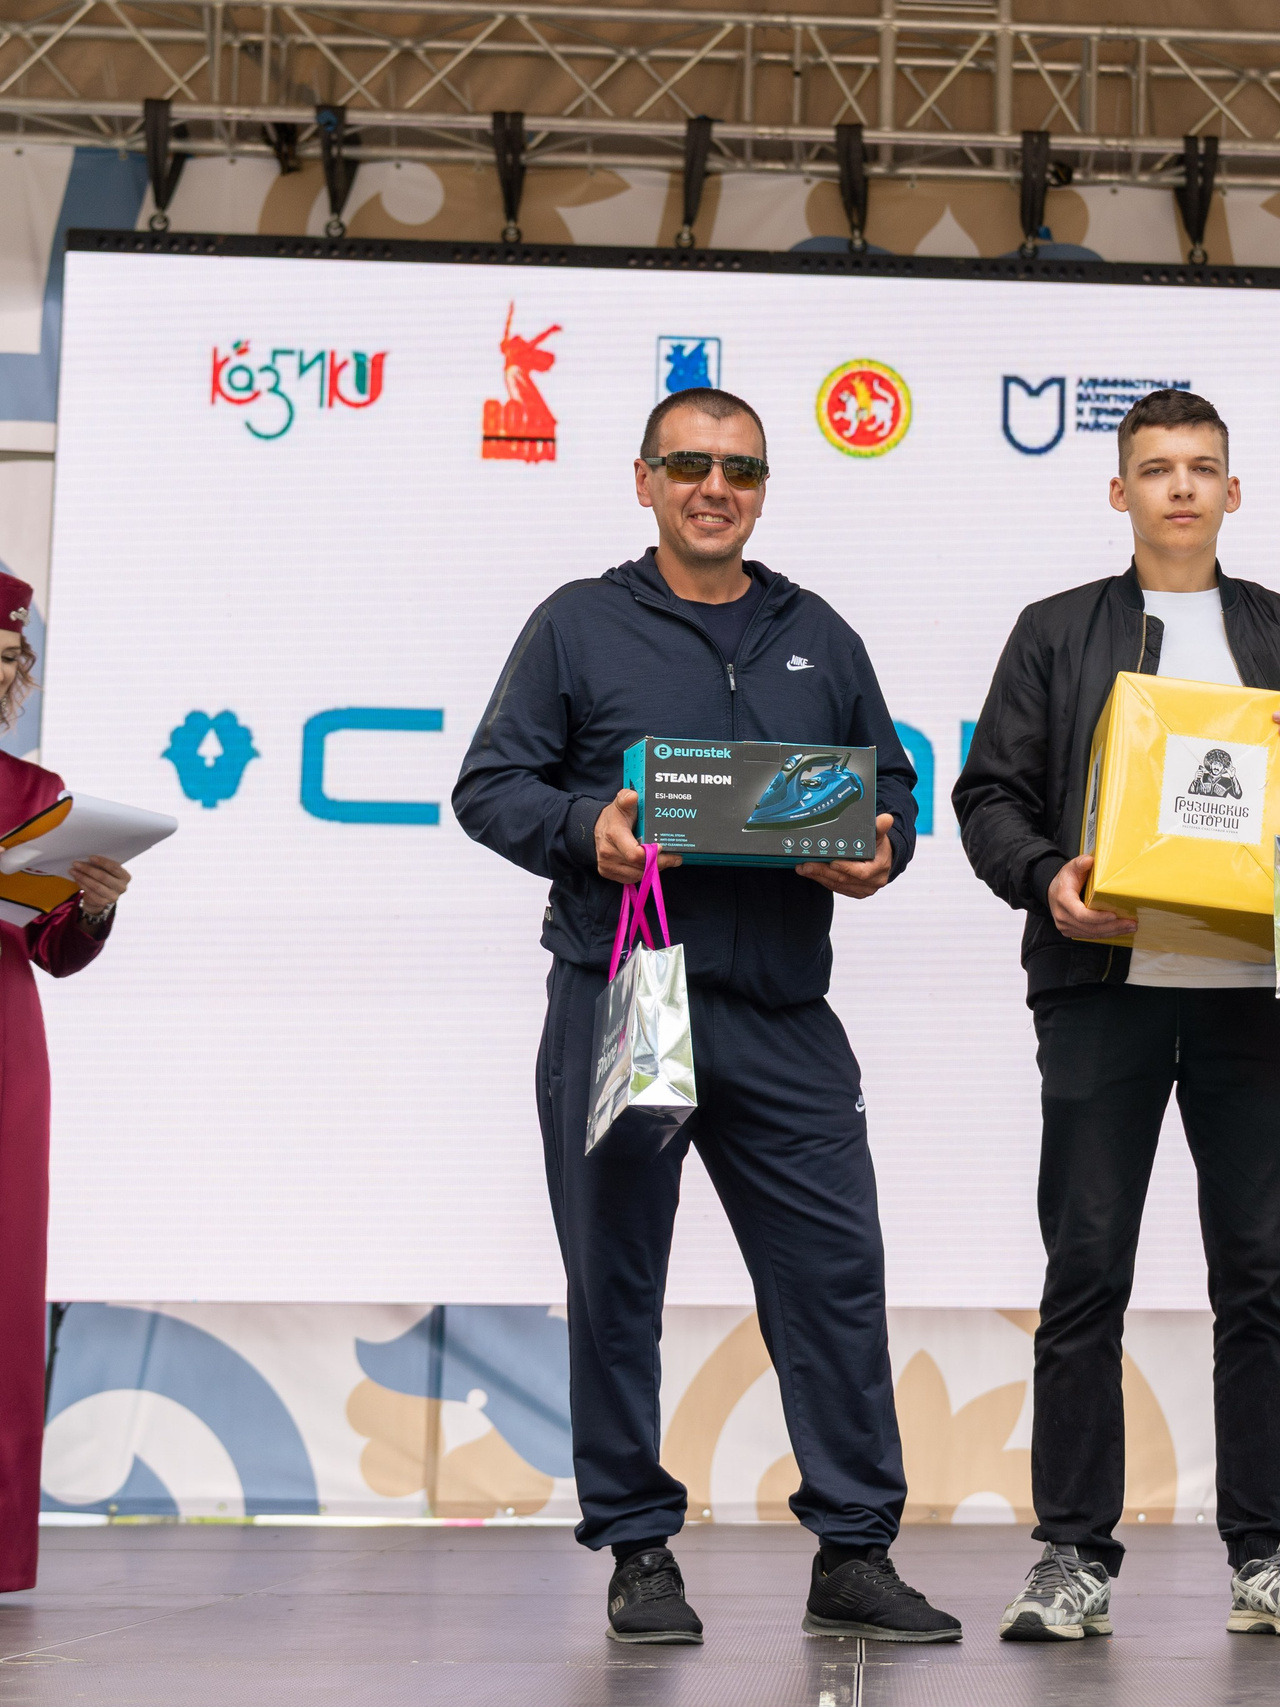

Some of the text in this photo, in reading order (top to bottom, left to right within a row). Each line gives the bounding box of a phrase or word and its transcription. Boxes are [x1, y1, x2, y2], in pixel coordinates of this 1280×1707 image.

[790, 654, 809, 667] NIKE
[672, 746, 732, 760] eurostek
[654, 772, 732, 786] STEAM IRON
[654, 806, 698, 820] 2400W
